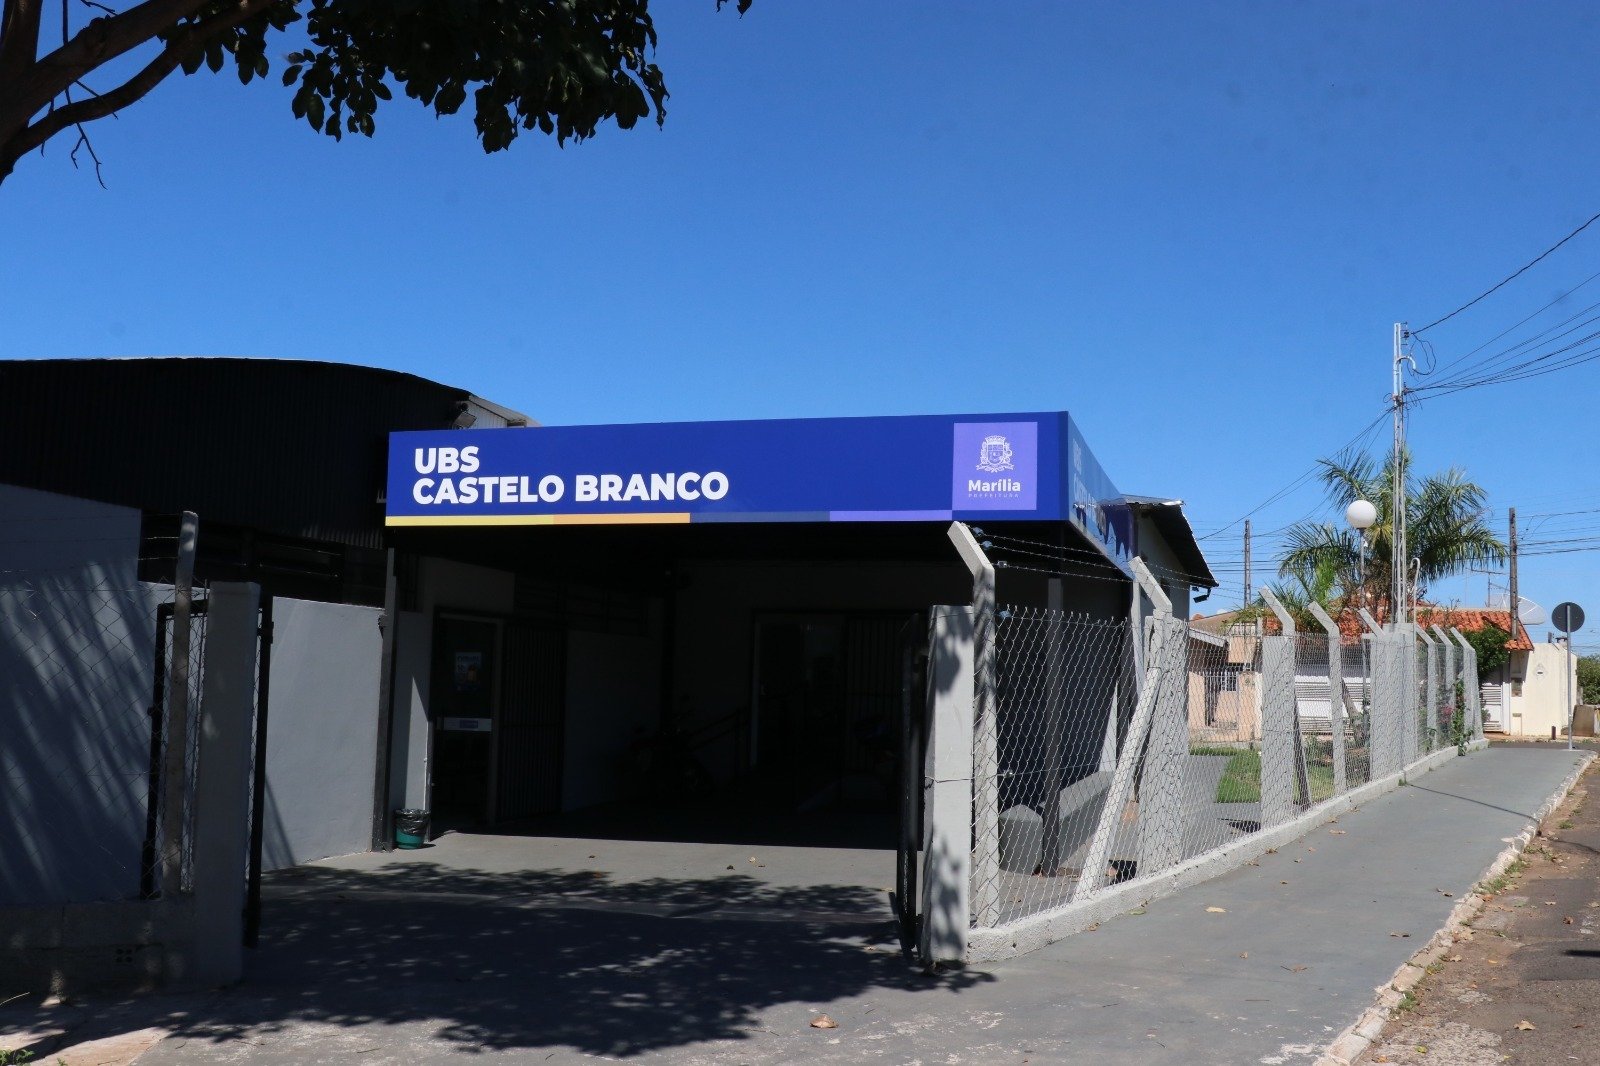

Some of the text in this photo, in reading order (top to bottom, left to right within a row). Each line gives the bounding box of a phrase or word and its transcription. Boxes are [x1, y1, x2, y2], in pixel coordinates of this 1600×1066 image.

[414, 445, 480, 474] UBS
[413, 471, 729, 505] CASTELO BRANCO
[968, 478, 1021, 492] Marília
